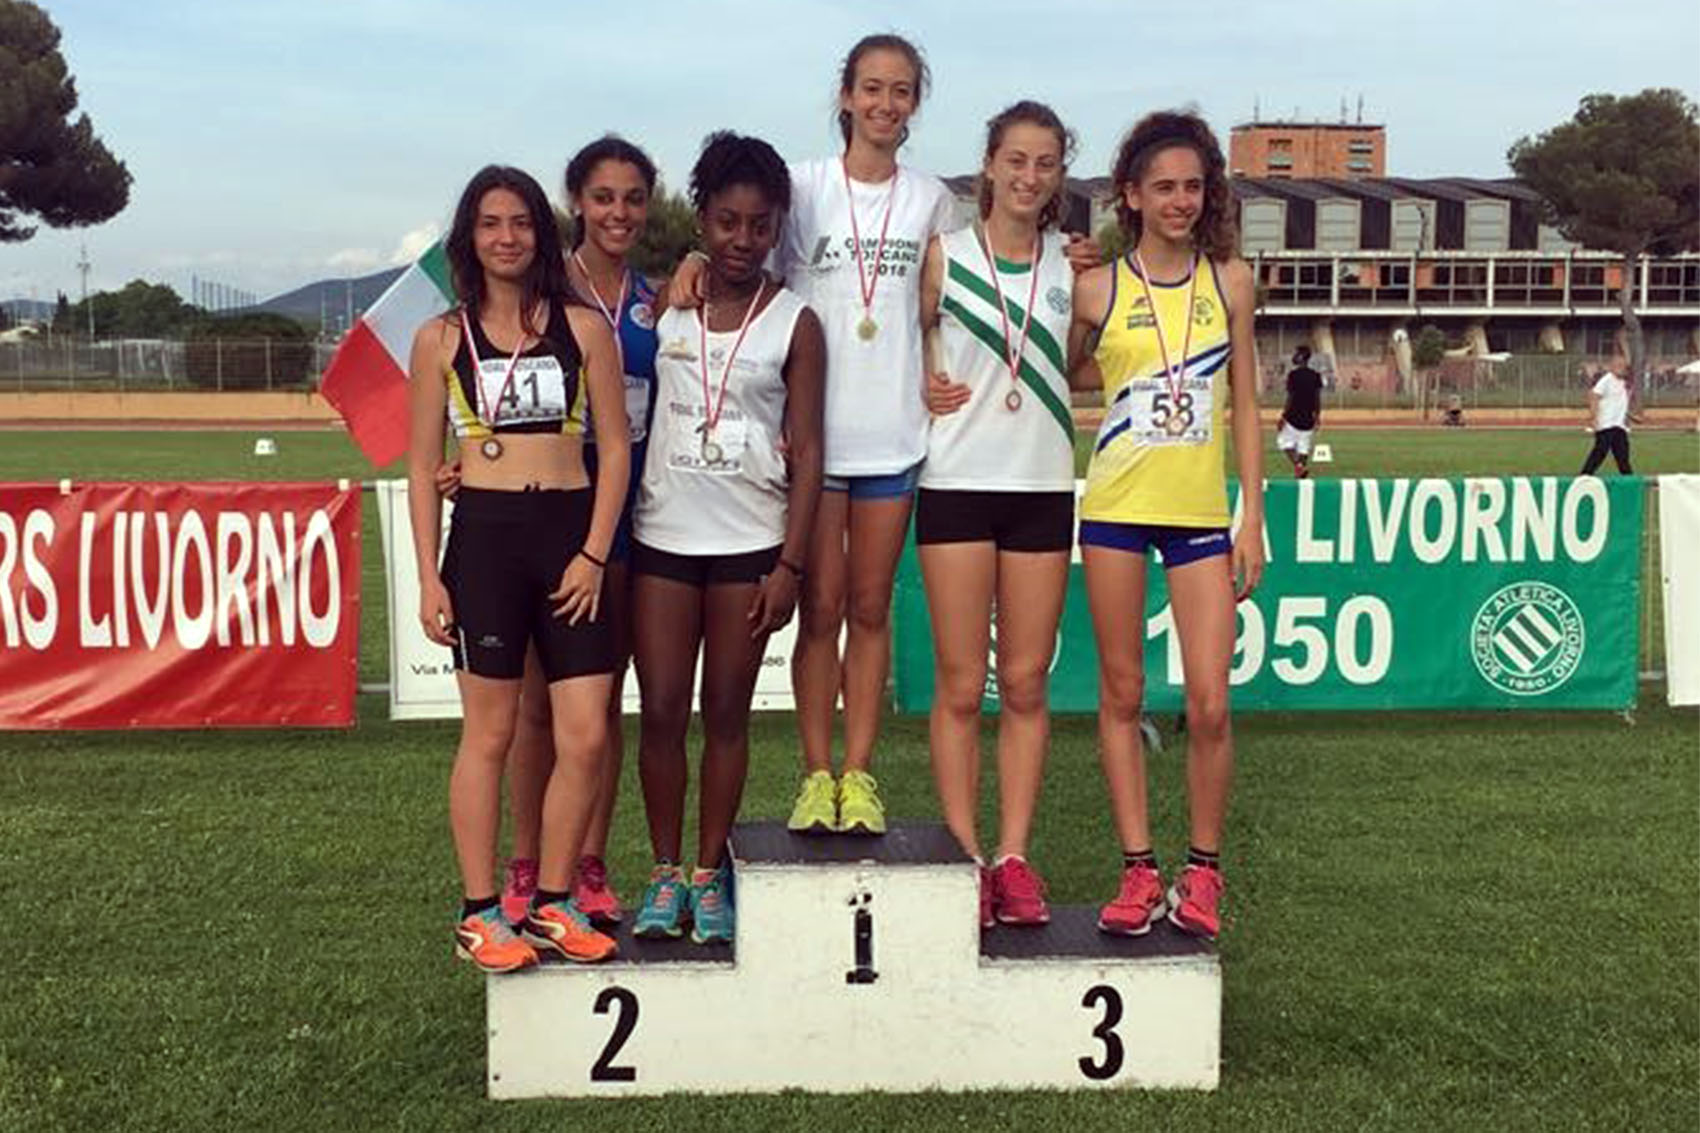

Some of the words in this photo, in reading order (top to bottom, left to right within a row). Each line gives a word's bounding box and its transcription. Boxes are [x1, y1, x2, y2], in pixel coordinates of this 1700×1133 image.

[502, 372, 539, 408] 41
[1152, 392, 1194, 428] 58
[1295, 476, 1610, 564] LIVORNO
[79, 508, 341, 651] LIVORNO
[1146, 594, 1393, 686] 1950
[590, 985, 639, 1082] 2
[1078, 984, 1125, 1080] 3
